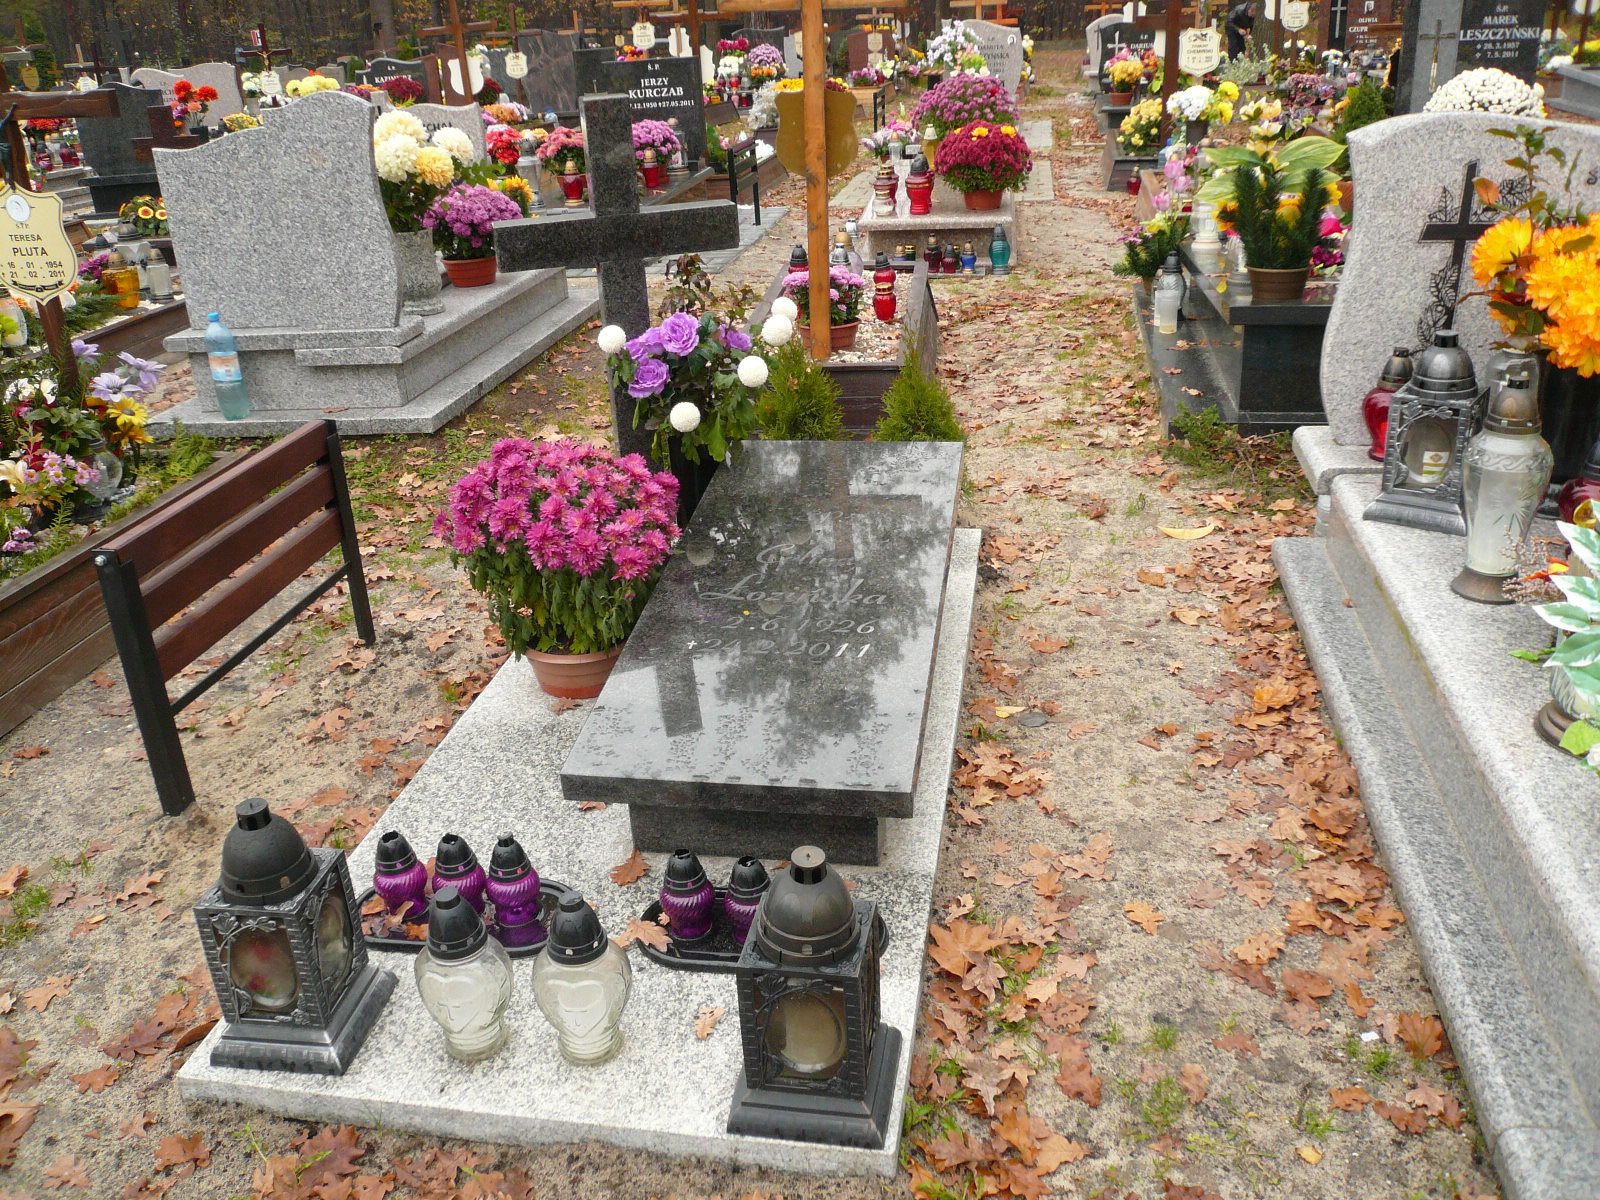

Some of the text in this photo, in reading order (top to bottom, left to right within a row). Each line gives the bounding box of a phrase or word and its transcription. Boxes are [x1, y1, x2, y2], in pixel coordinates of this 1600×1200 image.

[1482, 15, 1519, 25] MAREK
[1459, 25, 1540, 40] LESZCZYŃSKI
[640, 77, 669, 87] JERZY
[628, 87, 684, 99] KURCZAB
[8, 234, 42, 242] TERESA
[12, 247, 48, 256] PLUTA
